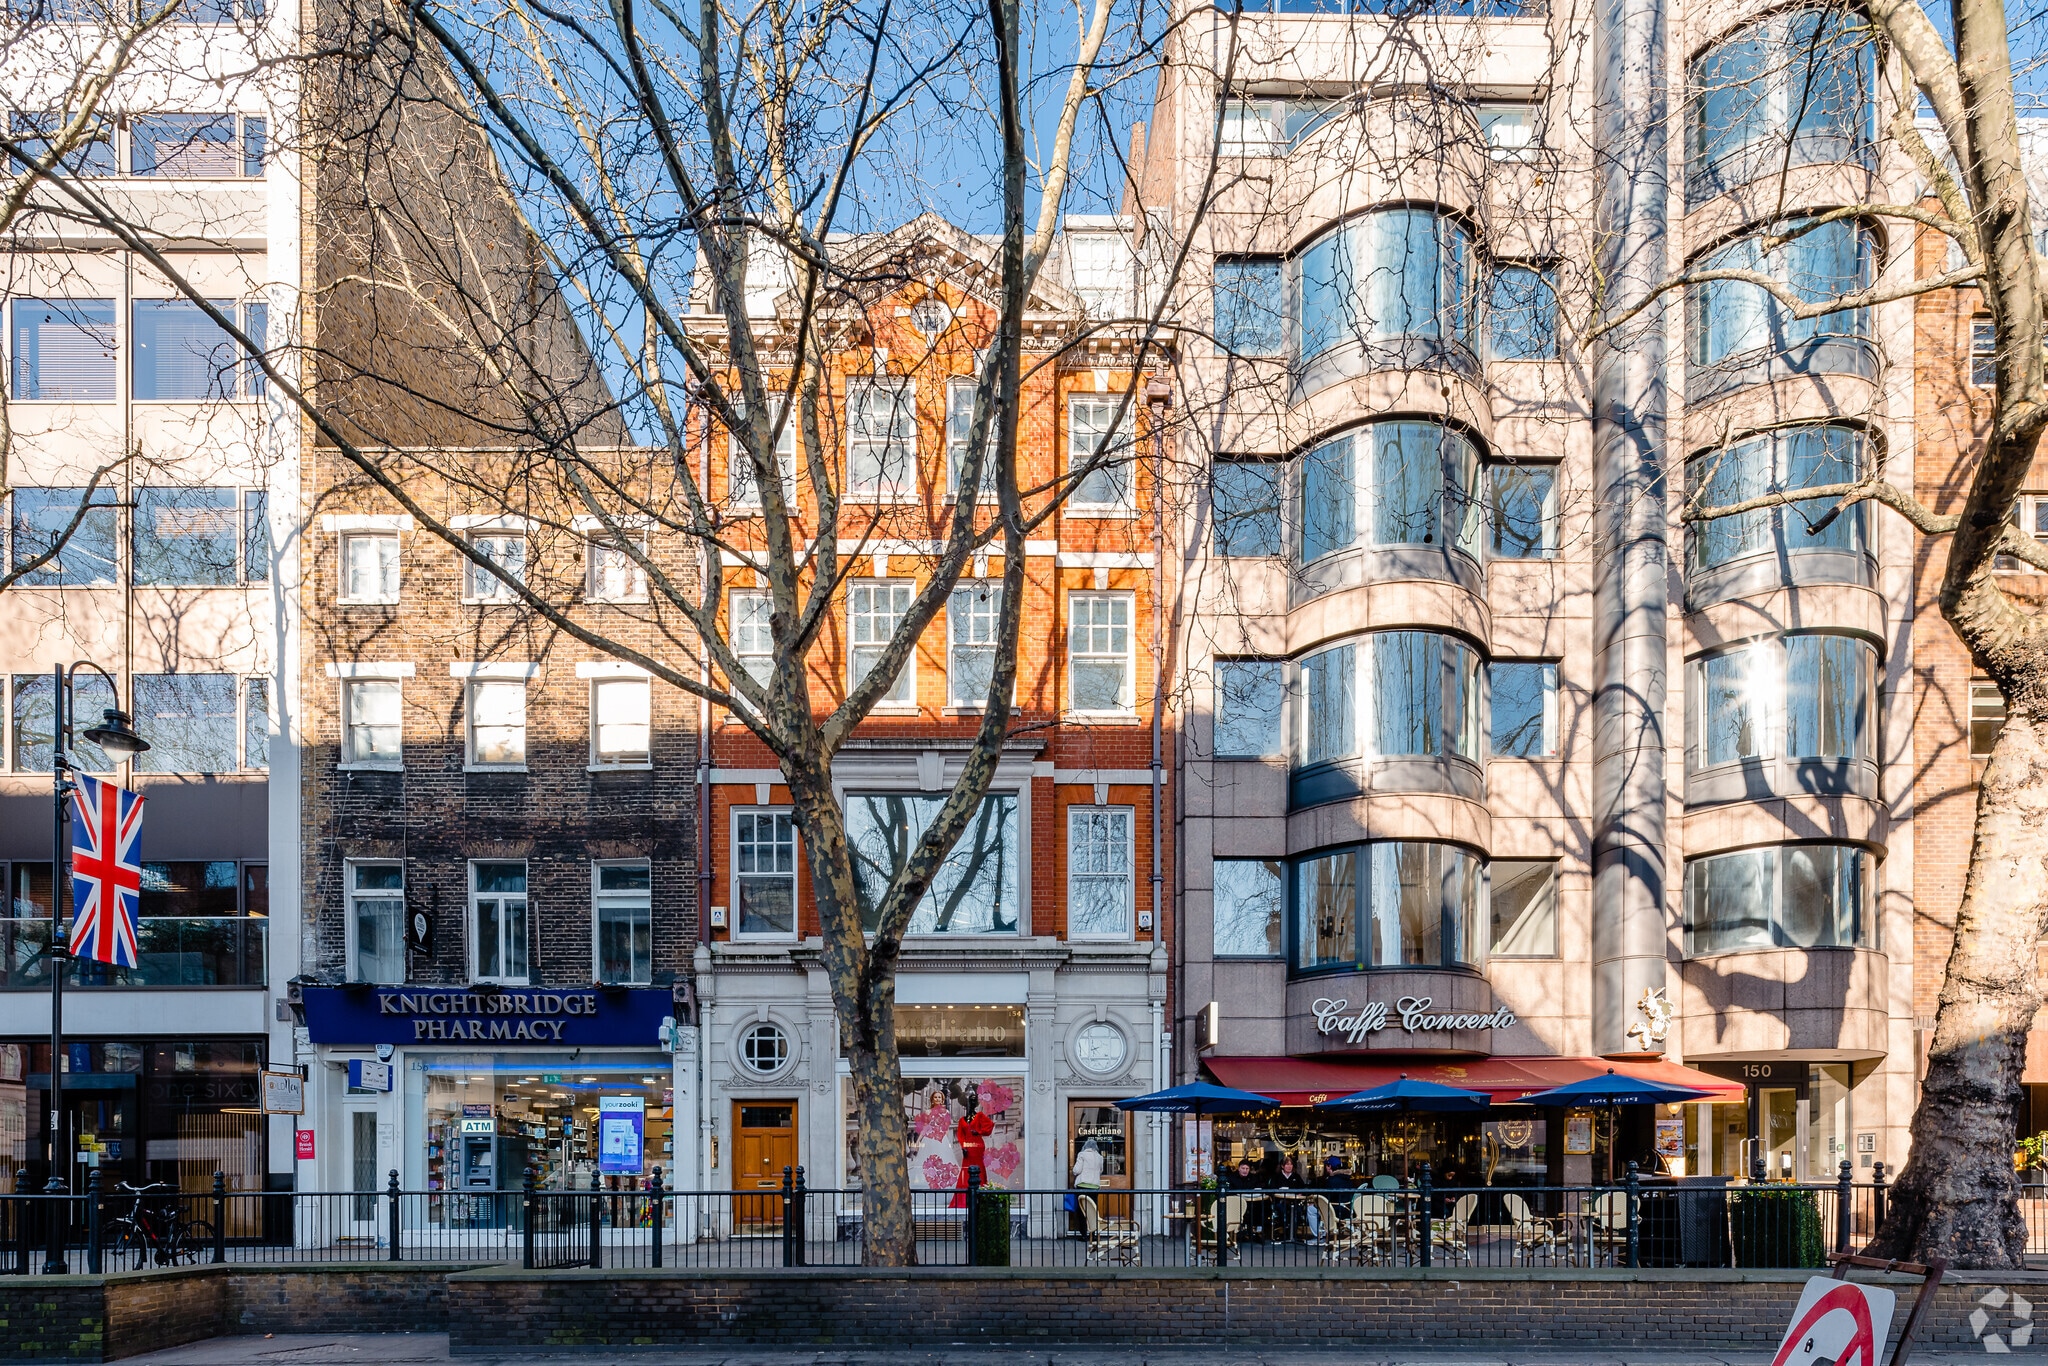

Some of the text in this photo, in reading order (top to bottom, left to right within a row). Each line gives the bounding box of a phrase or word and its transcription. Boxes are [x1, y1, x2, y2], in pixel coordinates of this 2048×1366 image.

[378, 993, 597, 1015] KNIGHTSBRIDGE
[1311, 995, 1517, 1044] Caffè Concerto
[413, 1019, 567, 1041] PHARMACY
[894, 1018, 1006, 1049] stigliano
[411, 1062, 429, 1072] 156
[1742, 1064, 1772, 1078] 150
[150, 1082, 195, 1099] one
[204, 1078, 259, 1102] sixty
[604, 1101, 638, 1109] yourzooki
[465, 1122, 491, 1131] ATM
[1078, 1126, 1122, 1137] Castigliano
